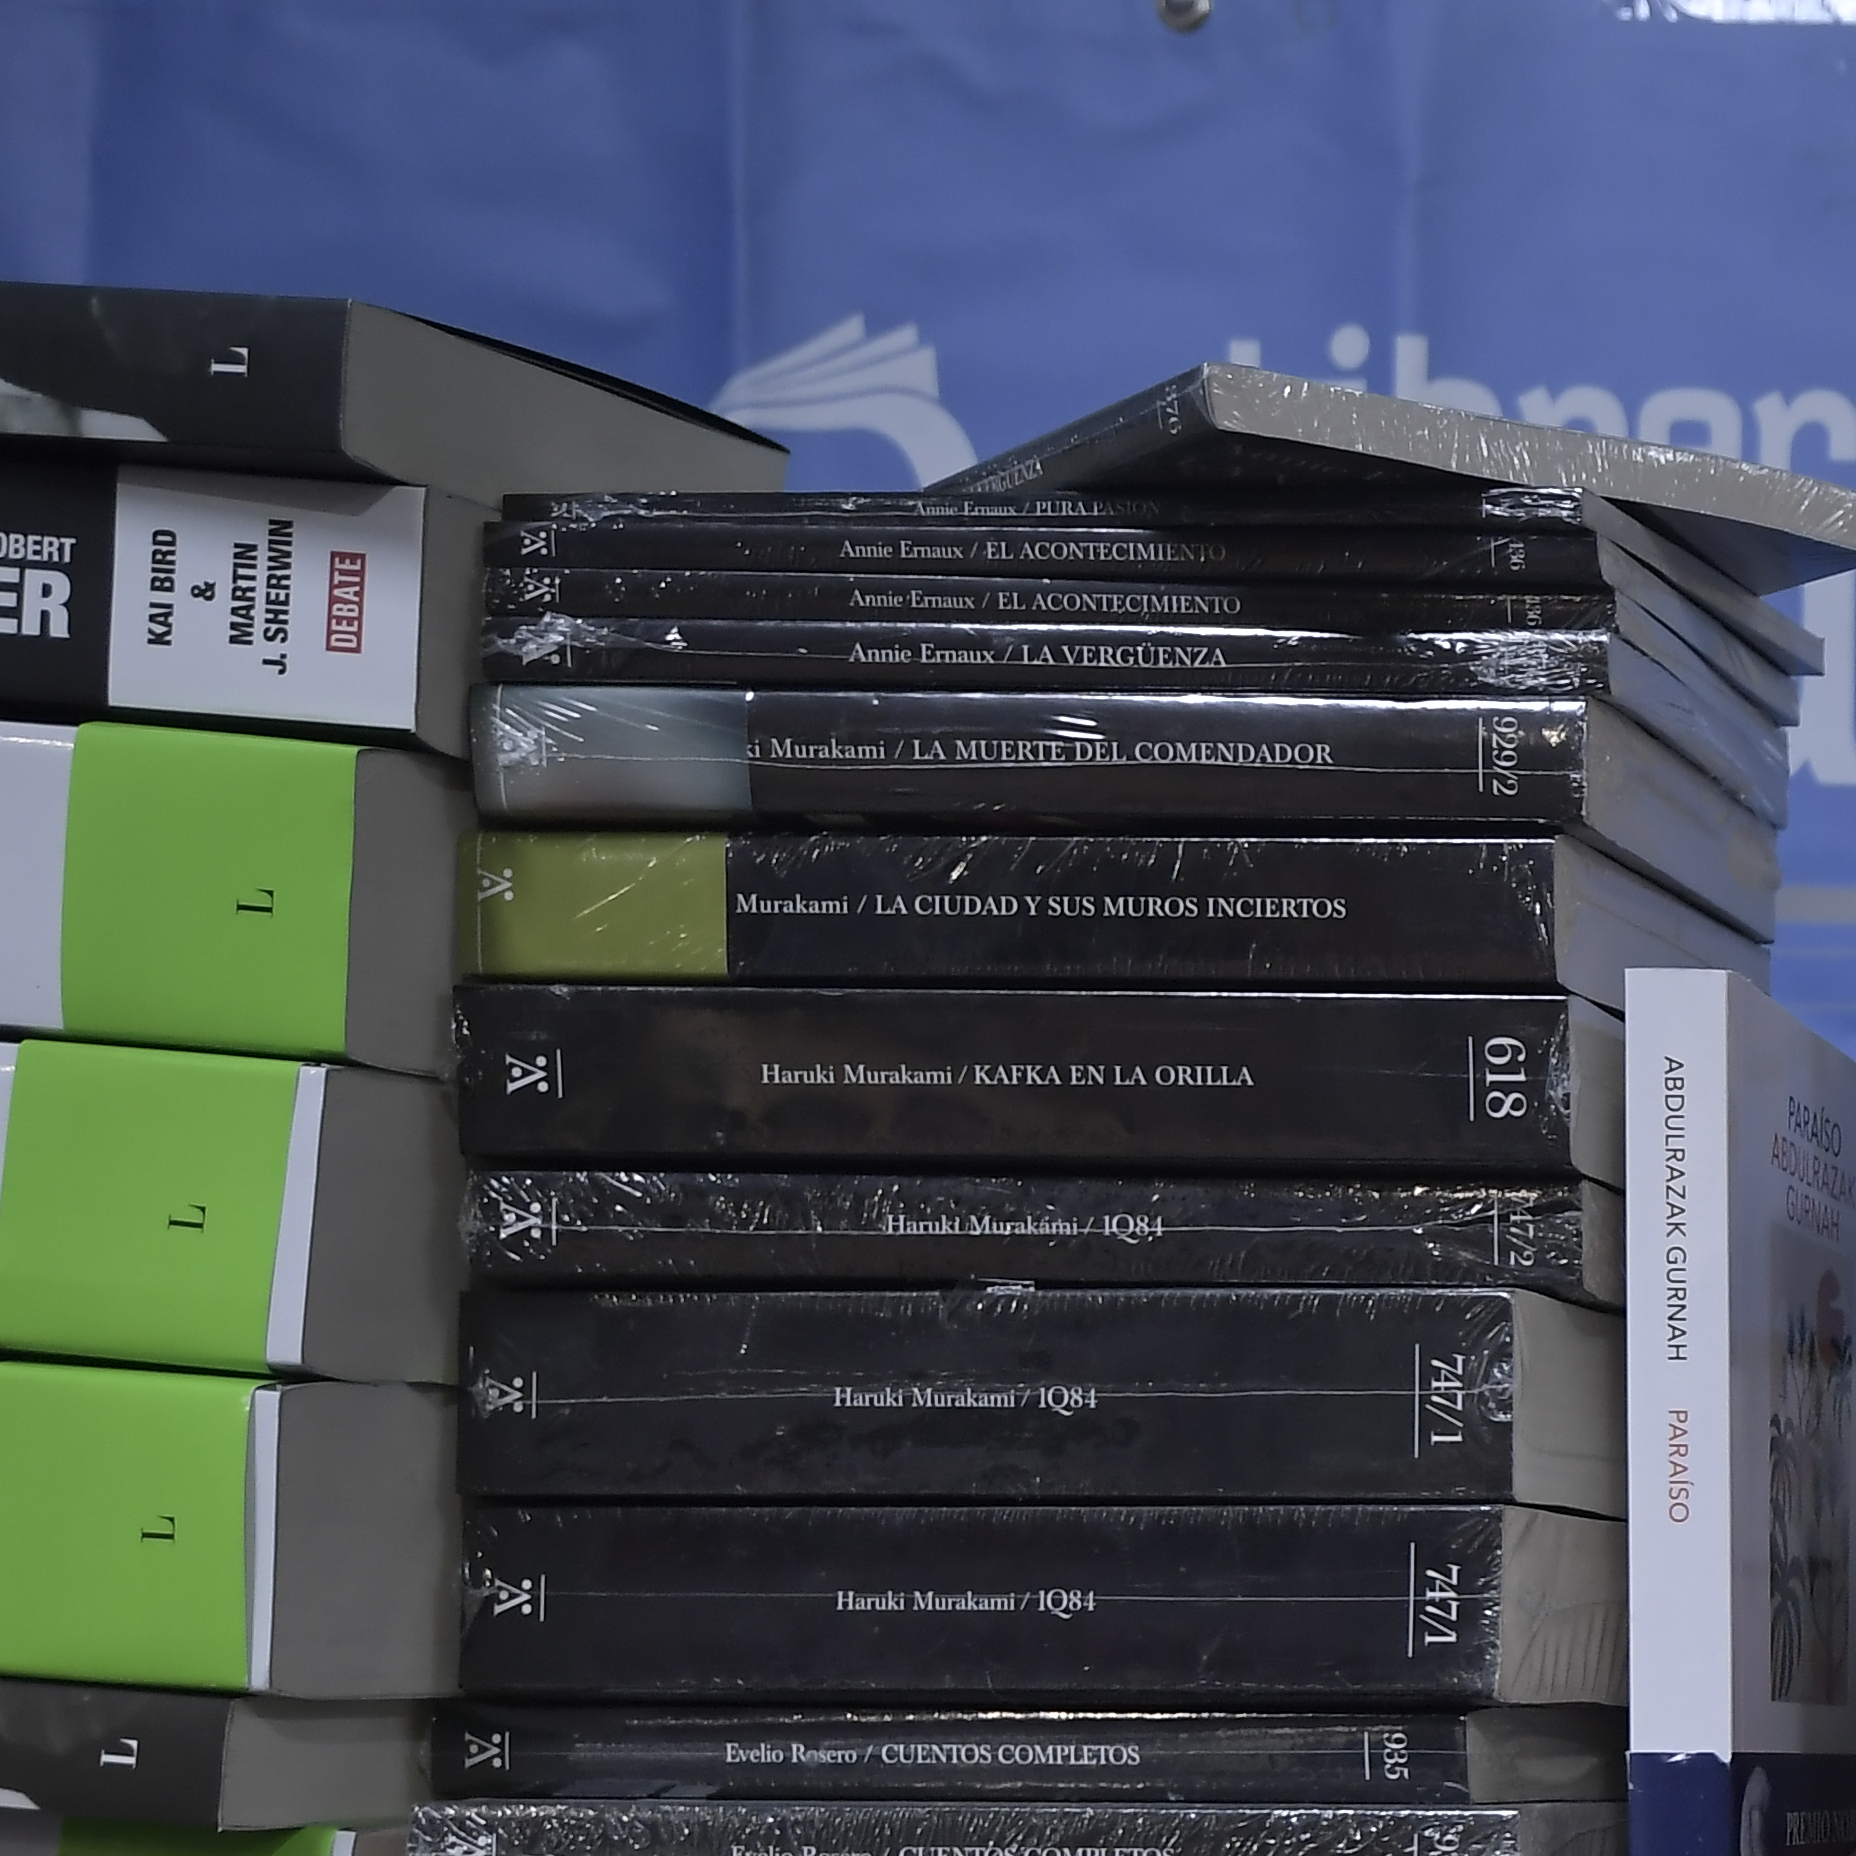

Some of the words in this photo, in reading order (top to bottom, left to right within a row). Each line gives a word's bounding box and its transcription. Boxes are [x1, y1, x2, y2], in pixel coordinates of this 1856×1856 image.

[151, 528, 177, 593] BIRD
[190, 580, 217, 602] &
[229, 542, 259, 645] MARTIN
[264, 519, 294, 643] SHERWIN
[330, 555, 362, 648] DEBATE
[147, 603, 174, 646] KAI
[1491, 715, 1519, 797] 929/2
[760, 1062, 835, 1087] Haruki
[843, 1061, 953, 1086] Murakami
[974, 1062, 1064, 1087] KAFKA
[1071, 1063, 1110, 1087] EN
[1115, 1063, 1150, 1087] LA
[1154, 1063, 1255, 1088] ORILLA
[1483, 1035, 1528, 1121] 618
[1663, 1055, 1688, 1238] ABDULRAZAK
[1665, 1245, 1688, 1361] GURNAH
[1431, 1353, 1465, 1446] 747/1
[1668, 1410, 1694, 1523] PARAÍSO
[1383, 1733, 1409, 1780] 935
